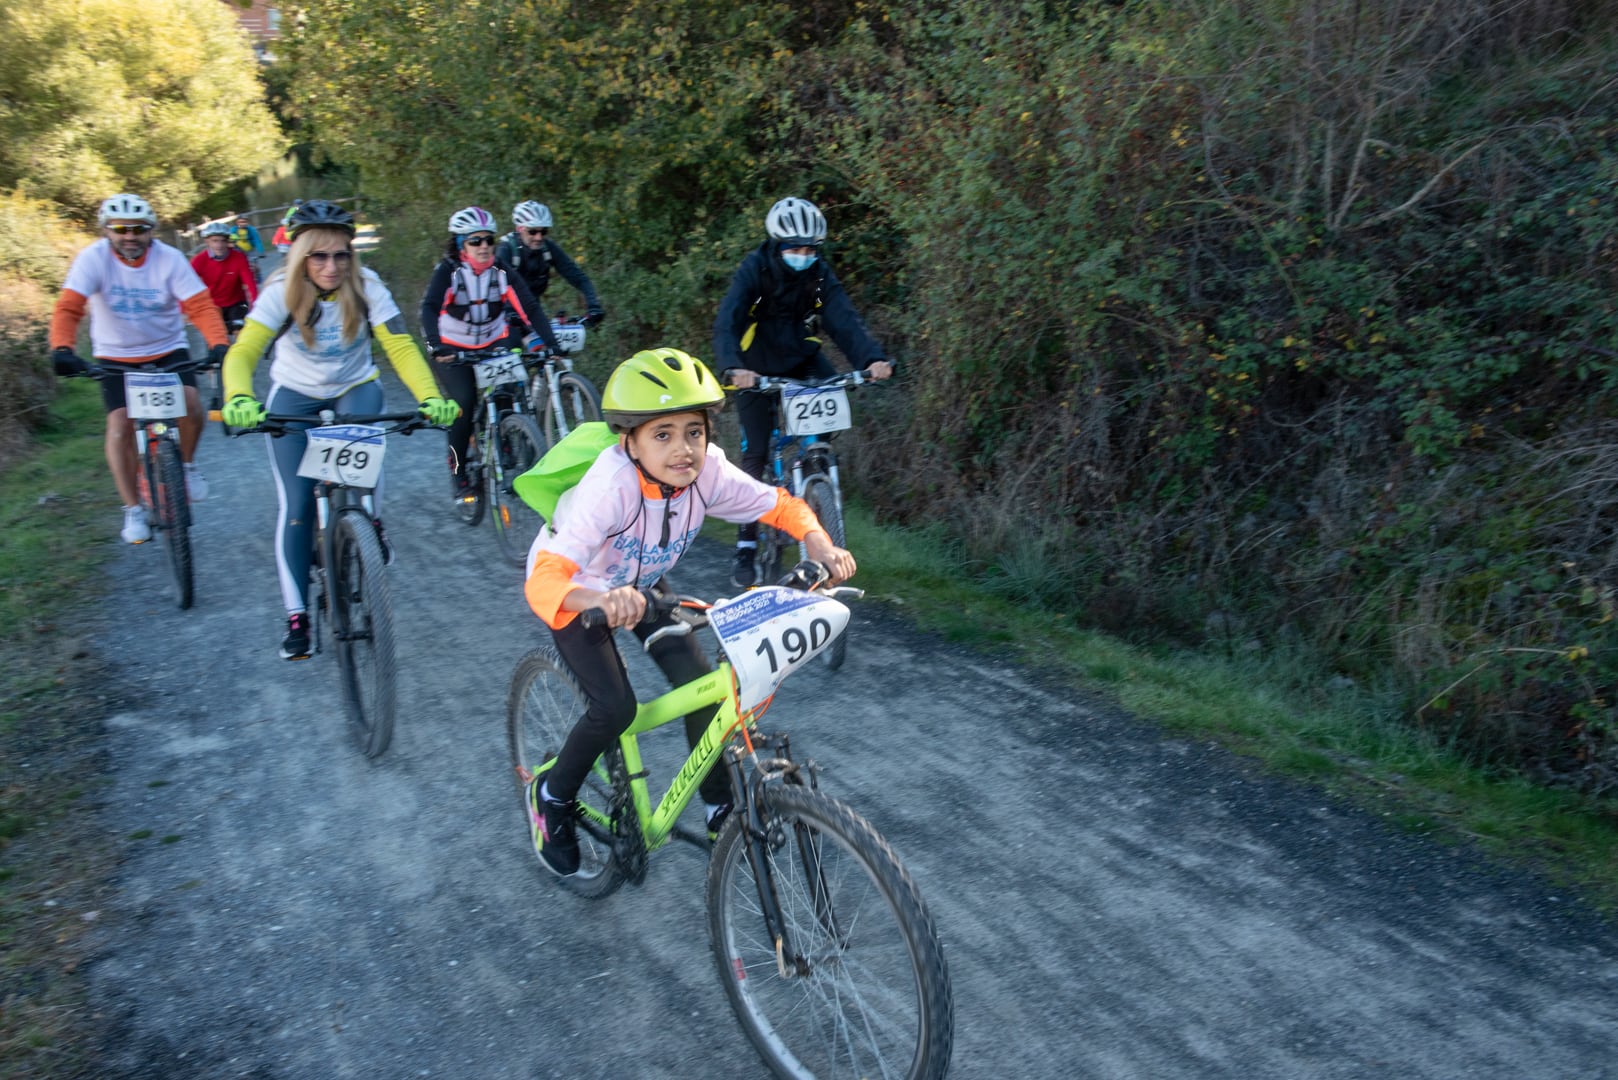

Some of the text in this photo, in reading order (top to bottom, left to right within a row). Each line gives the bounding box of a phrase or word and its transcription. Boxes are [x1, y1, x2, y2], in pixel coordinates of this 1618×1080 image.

[136, 391, 176, 407] 188
[796, 398, 837, 420] 249
[321, 447, 369, 470] 189
[756, 618, 831, 673] 190
